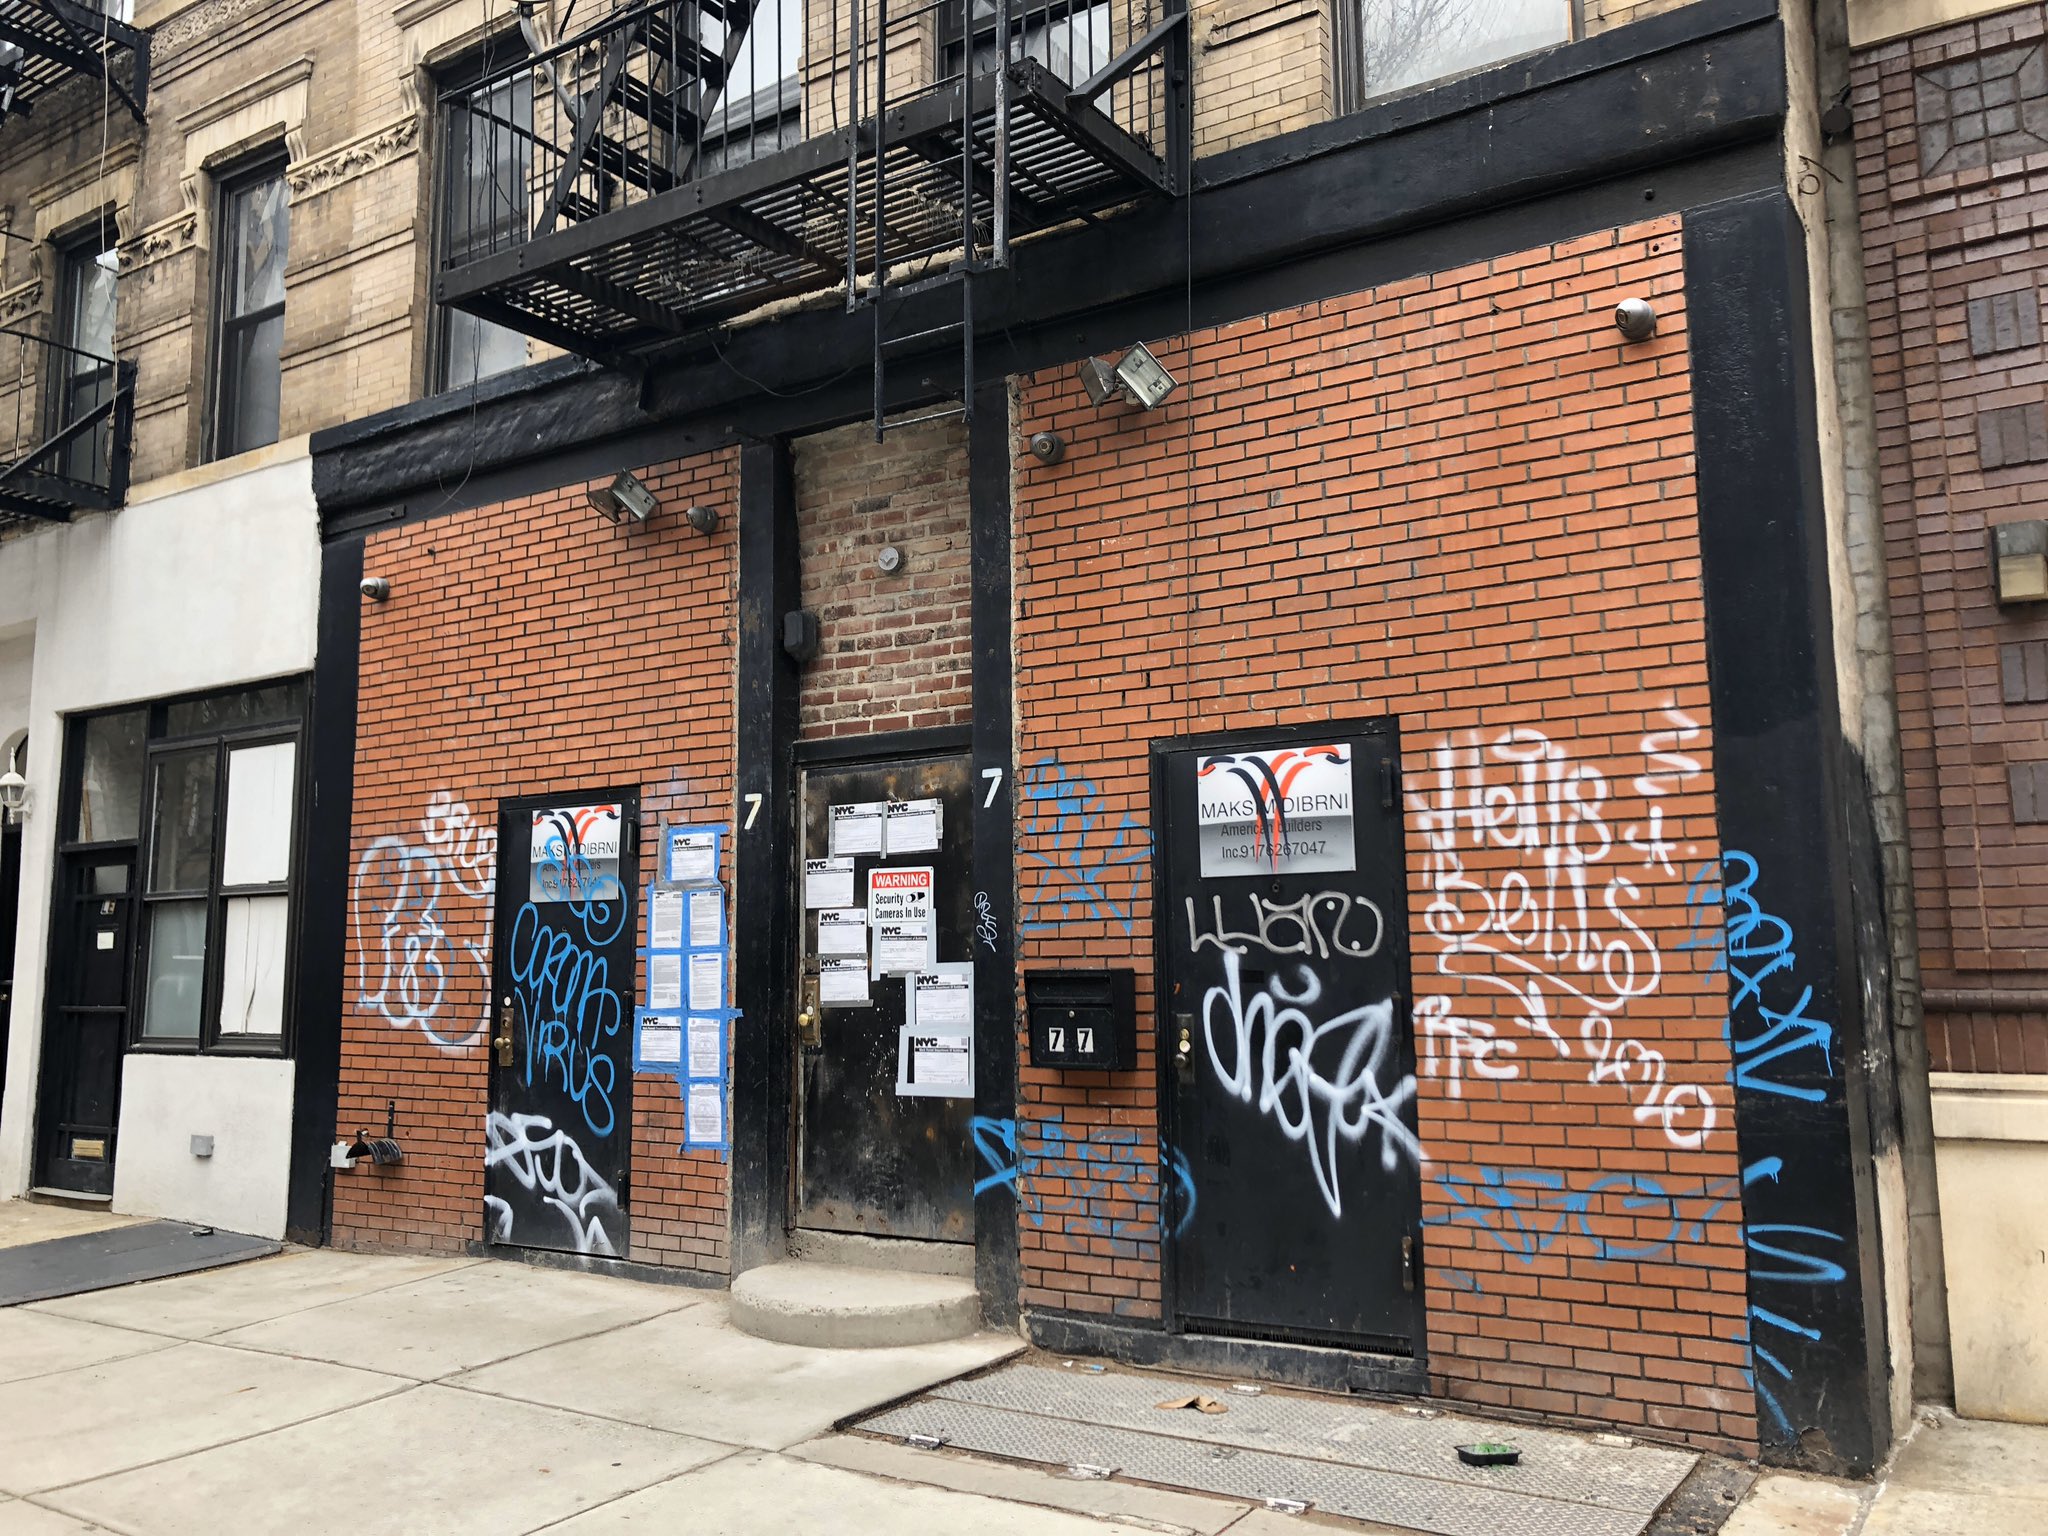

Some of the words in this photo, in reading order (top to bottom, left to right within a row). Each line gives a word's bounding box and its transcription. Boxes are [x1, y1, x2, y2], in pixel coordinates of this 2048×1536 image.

[982, 767, 1002, 809] 7
[744, 793, 762, 830] 7
[835, 806, 855, 815] NYC
[887, 803, 908, 813] NYC
[673, 838, 691, 847] NYC
[532, 844, 576, 858] MAKSM
[806, 861, 827, 870] NYC
[875, 873, 927, 888] WARNING
[875, 892, 904, 906] Security
[821, 913, 840, 921] NYC
[874, 907, 903, 919] Cameras
[905, 907, 912, 918] In
[913, 906, 926, 918] Use
[881, 926, 901, 935] NYC
[821, 959, 841, 967] NYC
[917, 975, 939, 985] NYC
[642, 1017, 659, 1025] NYC
[915, 1037, 938, 1047] NYC
